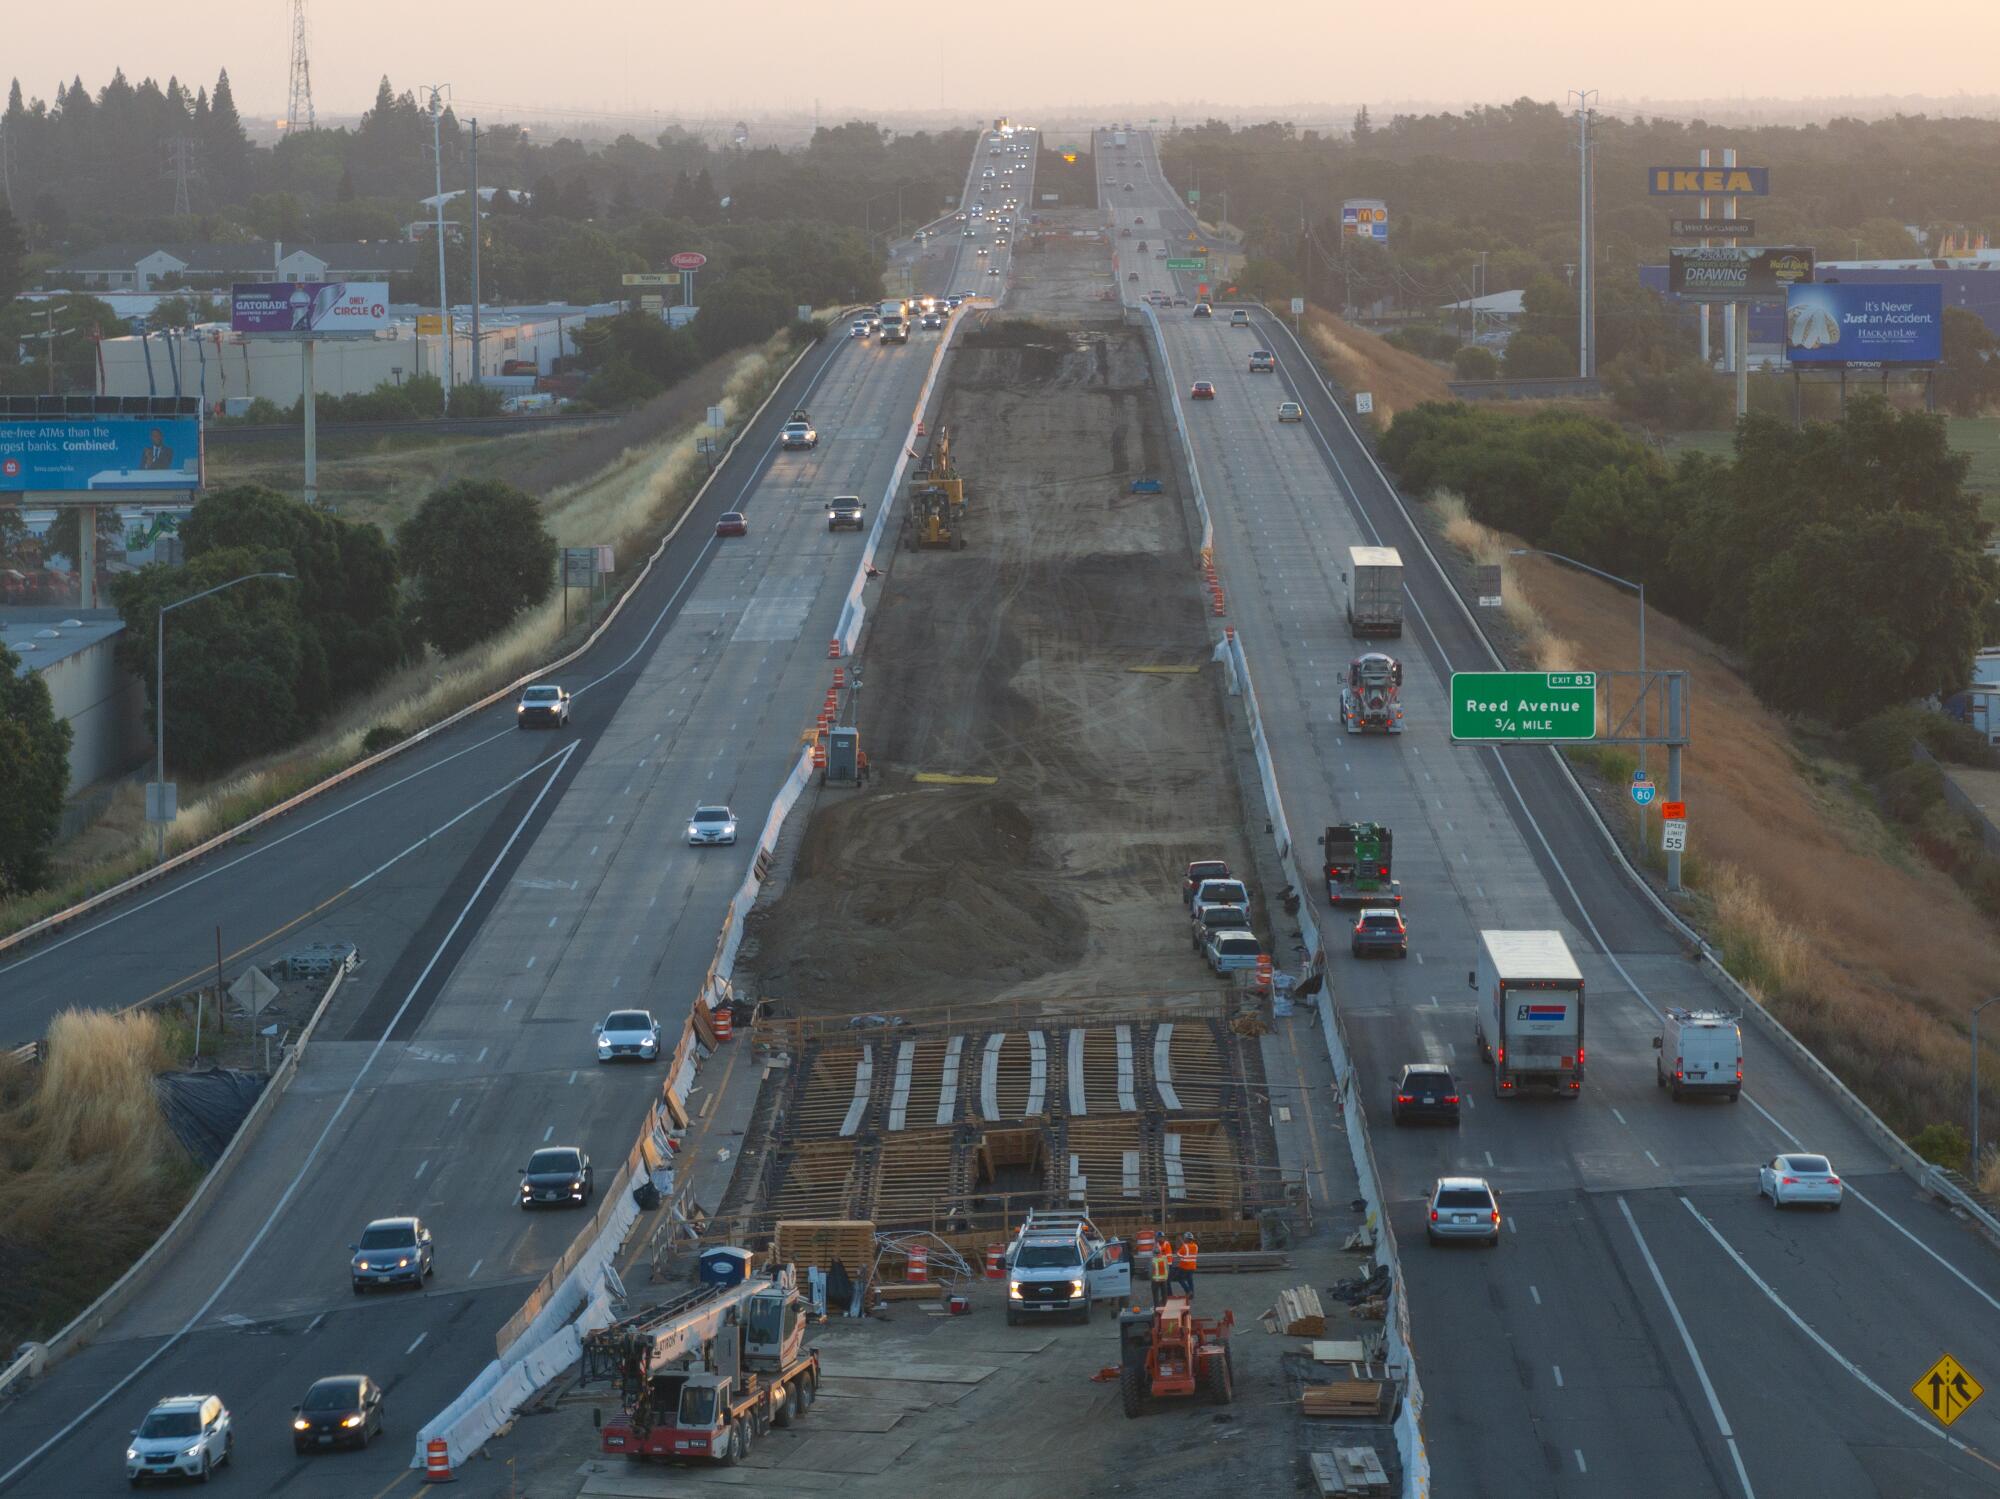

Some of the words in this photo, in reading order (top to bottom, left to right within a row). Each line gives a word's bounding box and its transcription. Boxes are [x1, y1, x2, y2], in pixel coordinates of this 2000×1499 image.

[1657, 171, 1754, 192] IKEA
[1686, 268, 1747, 281] DRAWING
[236, 301, 288, 310] GATORADE
[1865, 302, 1879, 312] It's
[1882, 302, 1913, 312] Never
[334, 307, 368, 316] CIRCLE
[1843, 313, 1867, 324] Just
[1870, 315, 1882, 323] an
[1883, 313, 1932, 324] Accident.
[39, 428, 65, 438] ATMs
[68, 427, 90, 438] than
[93, 427, 110, 438] the
[63, 439, 119, 451] Combined.
[1552, 676, 1570, 684] EXIT
[1575, 675, 1591, 685] 83
[1467, 700, 1508, 712] Reed
[1517, 700, 1580, 712] Avenue
[1523, 720, 1552, 730] MILE
[1637, 791, 1650, 800] 80
[1666, 838, 1682, 849] 55
